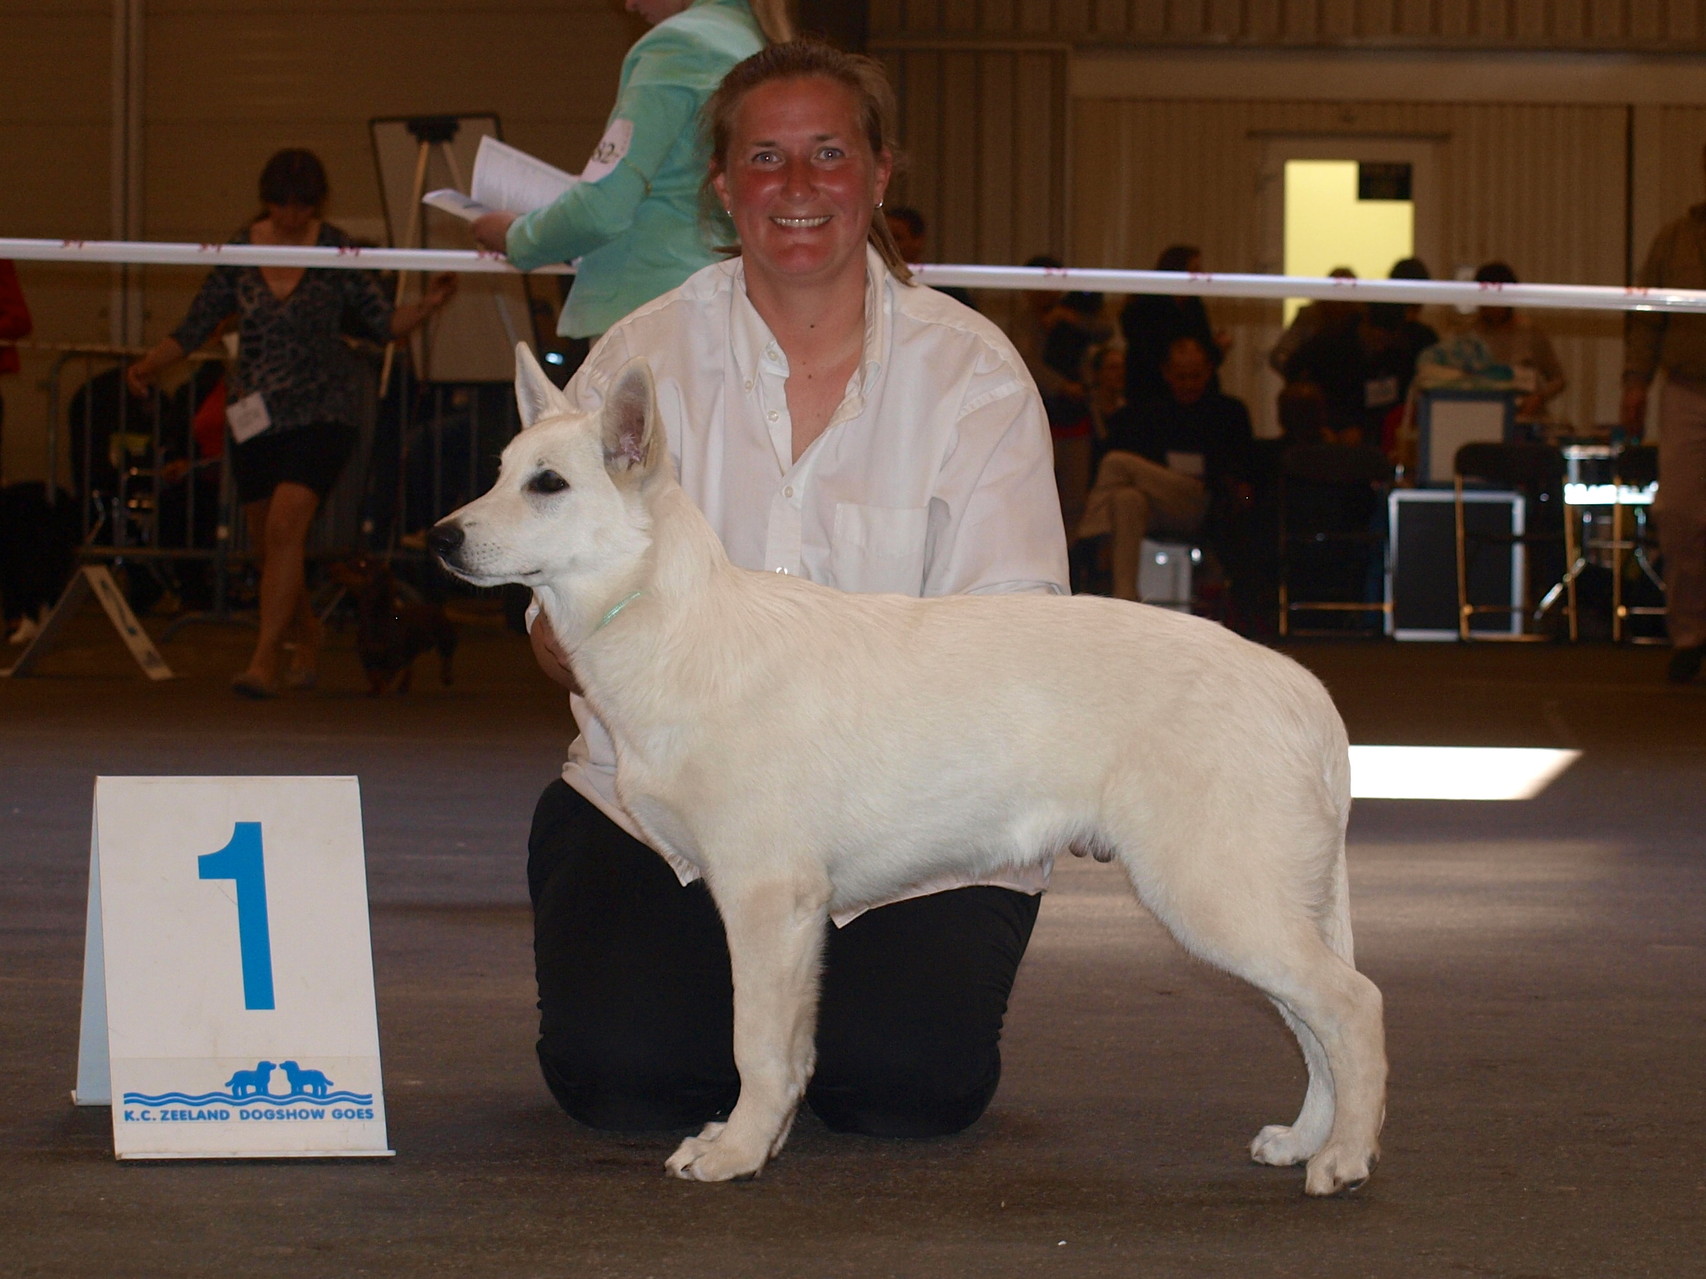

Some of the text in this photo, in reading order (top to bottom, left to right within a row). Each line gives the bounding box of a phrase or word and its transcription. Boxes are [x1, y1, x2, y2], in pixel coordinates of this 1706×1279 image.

[198, 821, 276, 1010] 1
[124, 1108, 374, 1122] K.C. ZEELAND DOGSHOW GOES
